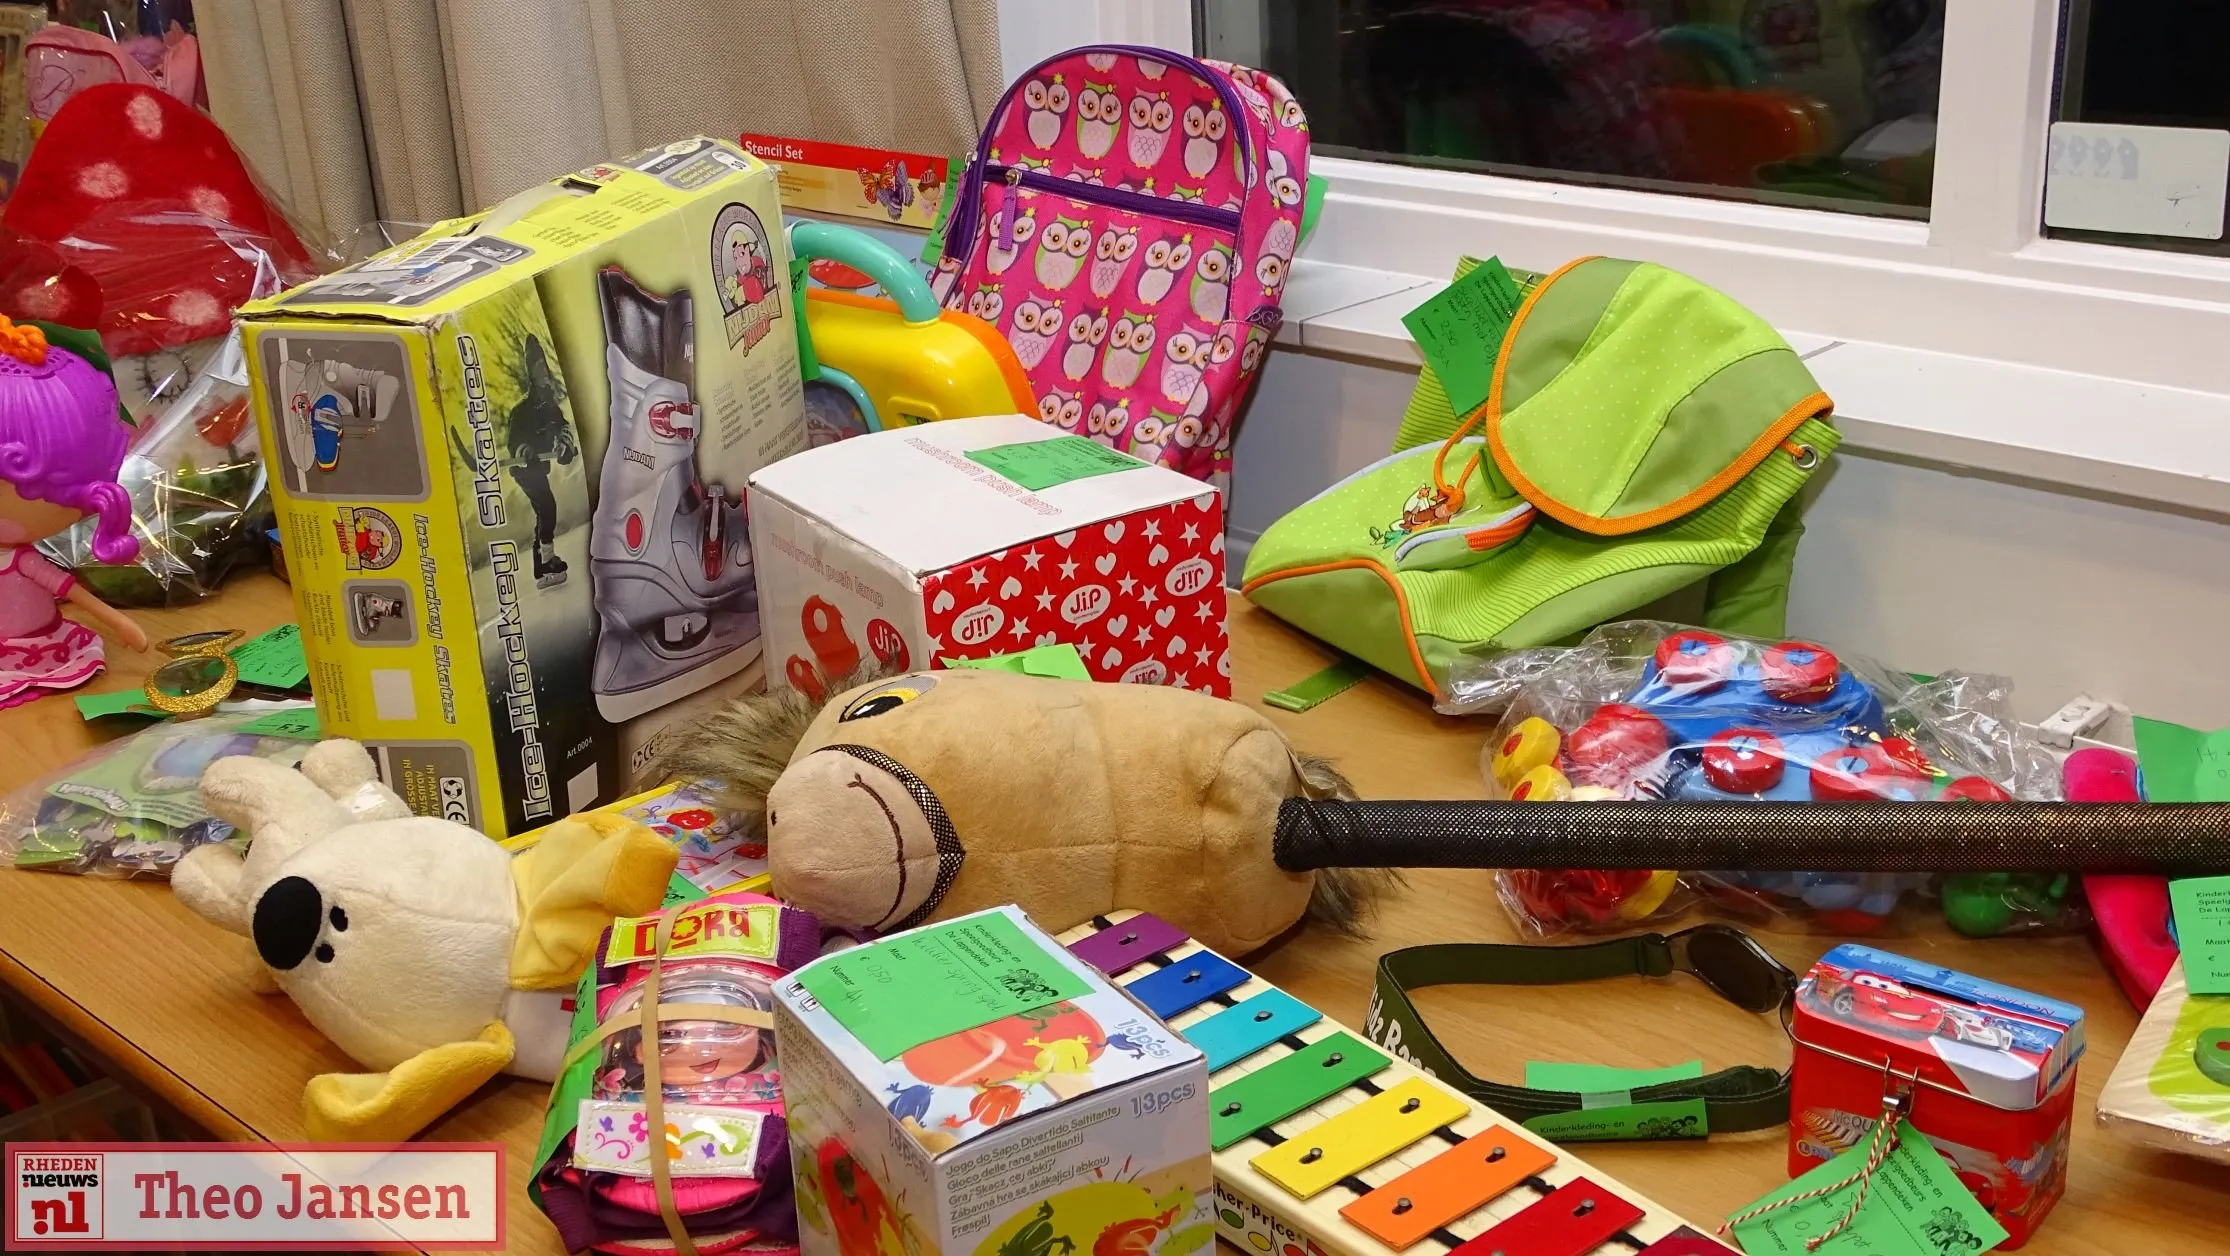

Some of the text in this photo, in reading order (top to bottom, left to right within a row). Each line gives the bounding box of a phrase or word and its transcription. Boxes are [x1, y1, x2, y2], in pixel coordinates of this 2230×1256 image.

[745, 141, 803, 161] Stencil Set
[457, 334, 508, 528] Skates
[904, 437, 984, 477] mushroom
[974, 474, 1023, 498] push
[1016, 493, 1063, 516] lamp
[771, 532, 885, 609] mushroom push lamp
[413, 513, 457, 725] Ice-Hockey Skates
[489, 540, 552, 821] Ice-Hockey
[887, 948, 906, 961] Maat
[945, 930, 990, 968] De Lappendeken
[830, 965, 855, 987] Nummer
[1972, 988, 2057, 1016] LONDON
[1113, 1018, 1171, 1058] 13pcs
[1130, 1082, 1196, 1118] 13pcs
[1834, 1109, 1875, 1132] McQU
[946, 1106, 1121, 1178] Jogo do Sapo Divertido Saltitante
[947, 1131, 1083, 1191] Gioco delle rane saltellanti
[1875, 1168, 1914, 1213] Lappendeken
[1887, 1152, 1928, 1202] eelgoedbeurs
[1898, 1143, 1945, 1199] nderkleding- en
[996, 1191, 1014, 1206] hra
[1014, 1186, 1028, 1197] se
[1789, 1205, 1800, 1213] €
[1762, 1218, 1788, 1252] Nummer
